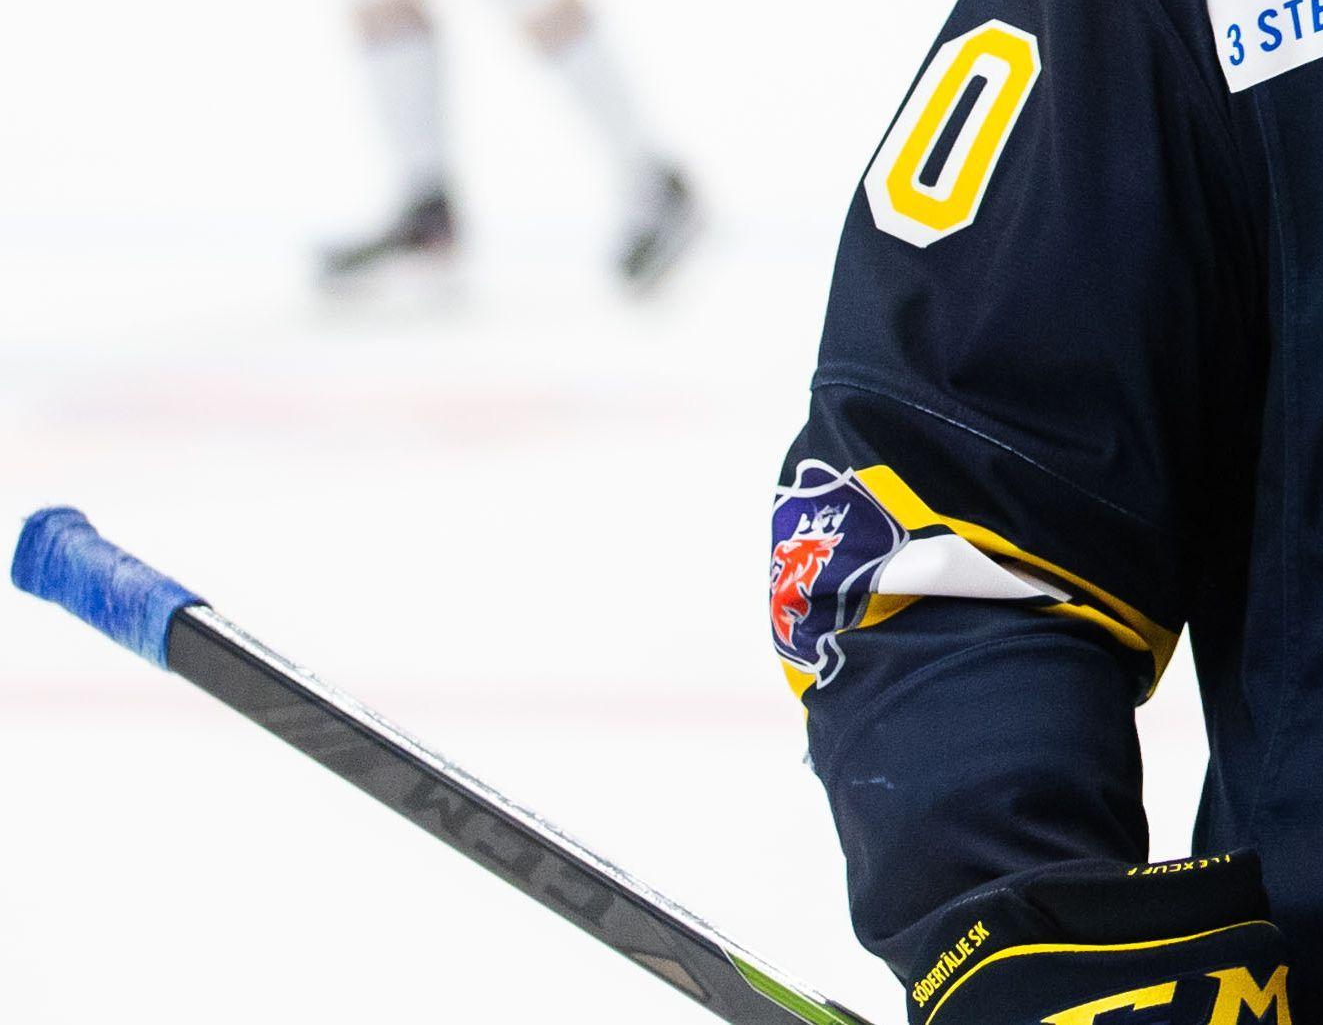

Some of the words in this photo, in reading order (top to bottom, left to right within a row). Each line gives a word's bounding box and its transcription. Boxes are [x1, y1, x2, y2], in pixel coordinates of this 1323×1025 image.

[1225, 23, 1246, 67] 3
[863, 18, 1042, 249] 0
[912, 937, 975, 1008] SÖDERTÄLJE
[967, 920, 991, 947] SK
